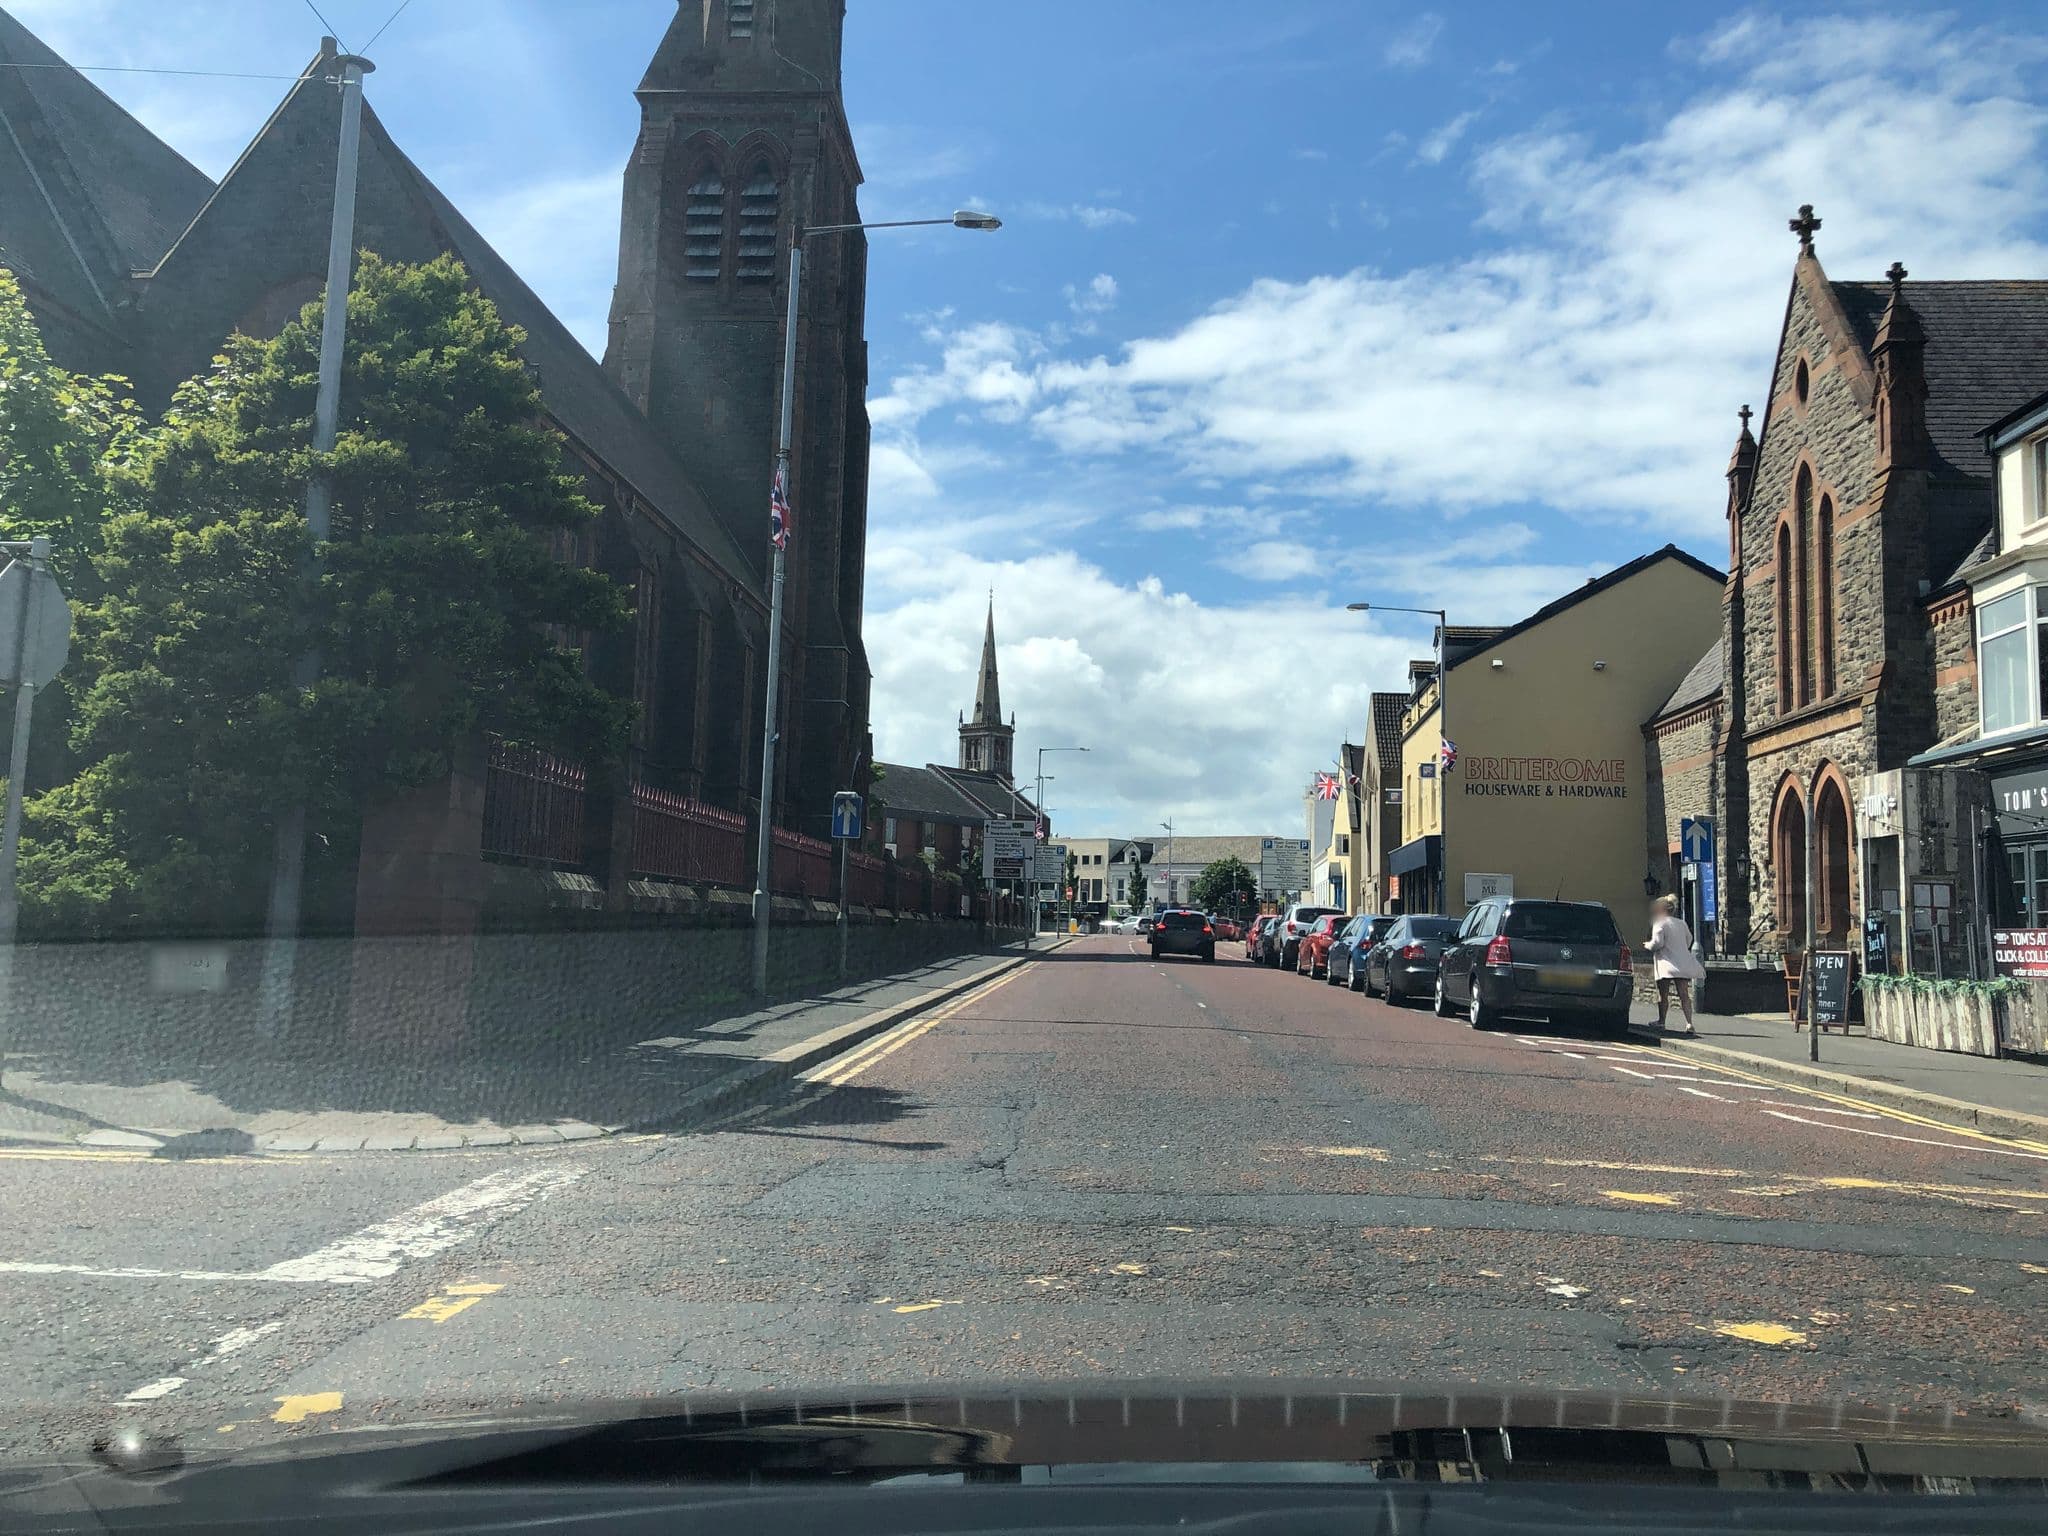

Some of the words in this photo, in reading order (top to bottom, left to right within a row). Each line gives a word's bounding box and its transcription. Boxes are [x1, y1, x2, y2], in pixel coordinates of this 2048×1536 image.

[1464, 757, 1625, 782] BRITEROME
[1465, 783, 1541, 797] HOUSEWARE
[1545, 786, 1554, 797] &
[1559, 786, 1628, 799] HARDWARE
[2003, 787, 2048, 812] TOM'S
[2010, 932, 2036, 946] TOM'S
[2037, 932, 2048, 946] AT
[1995, 949, 2018, 963] CLICK
[2018, 950, 2025, 963] &
